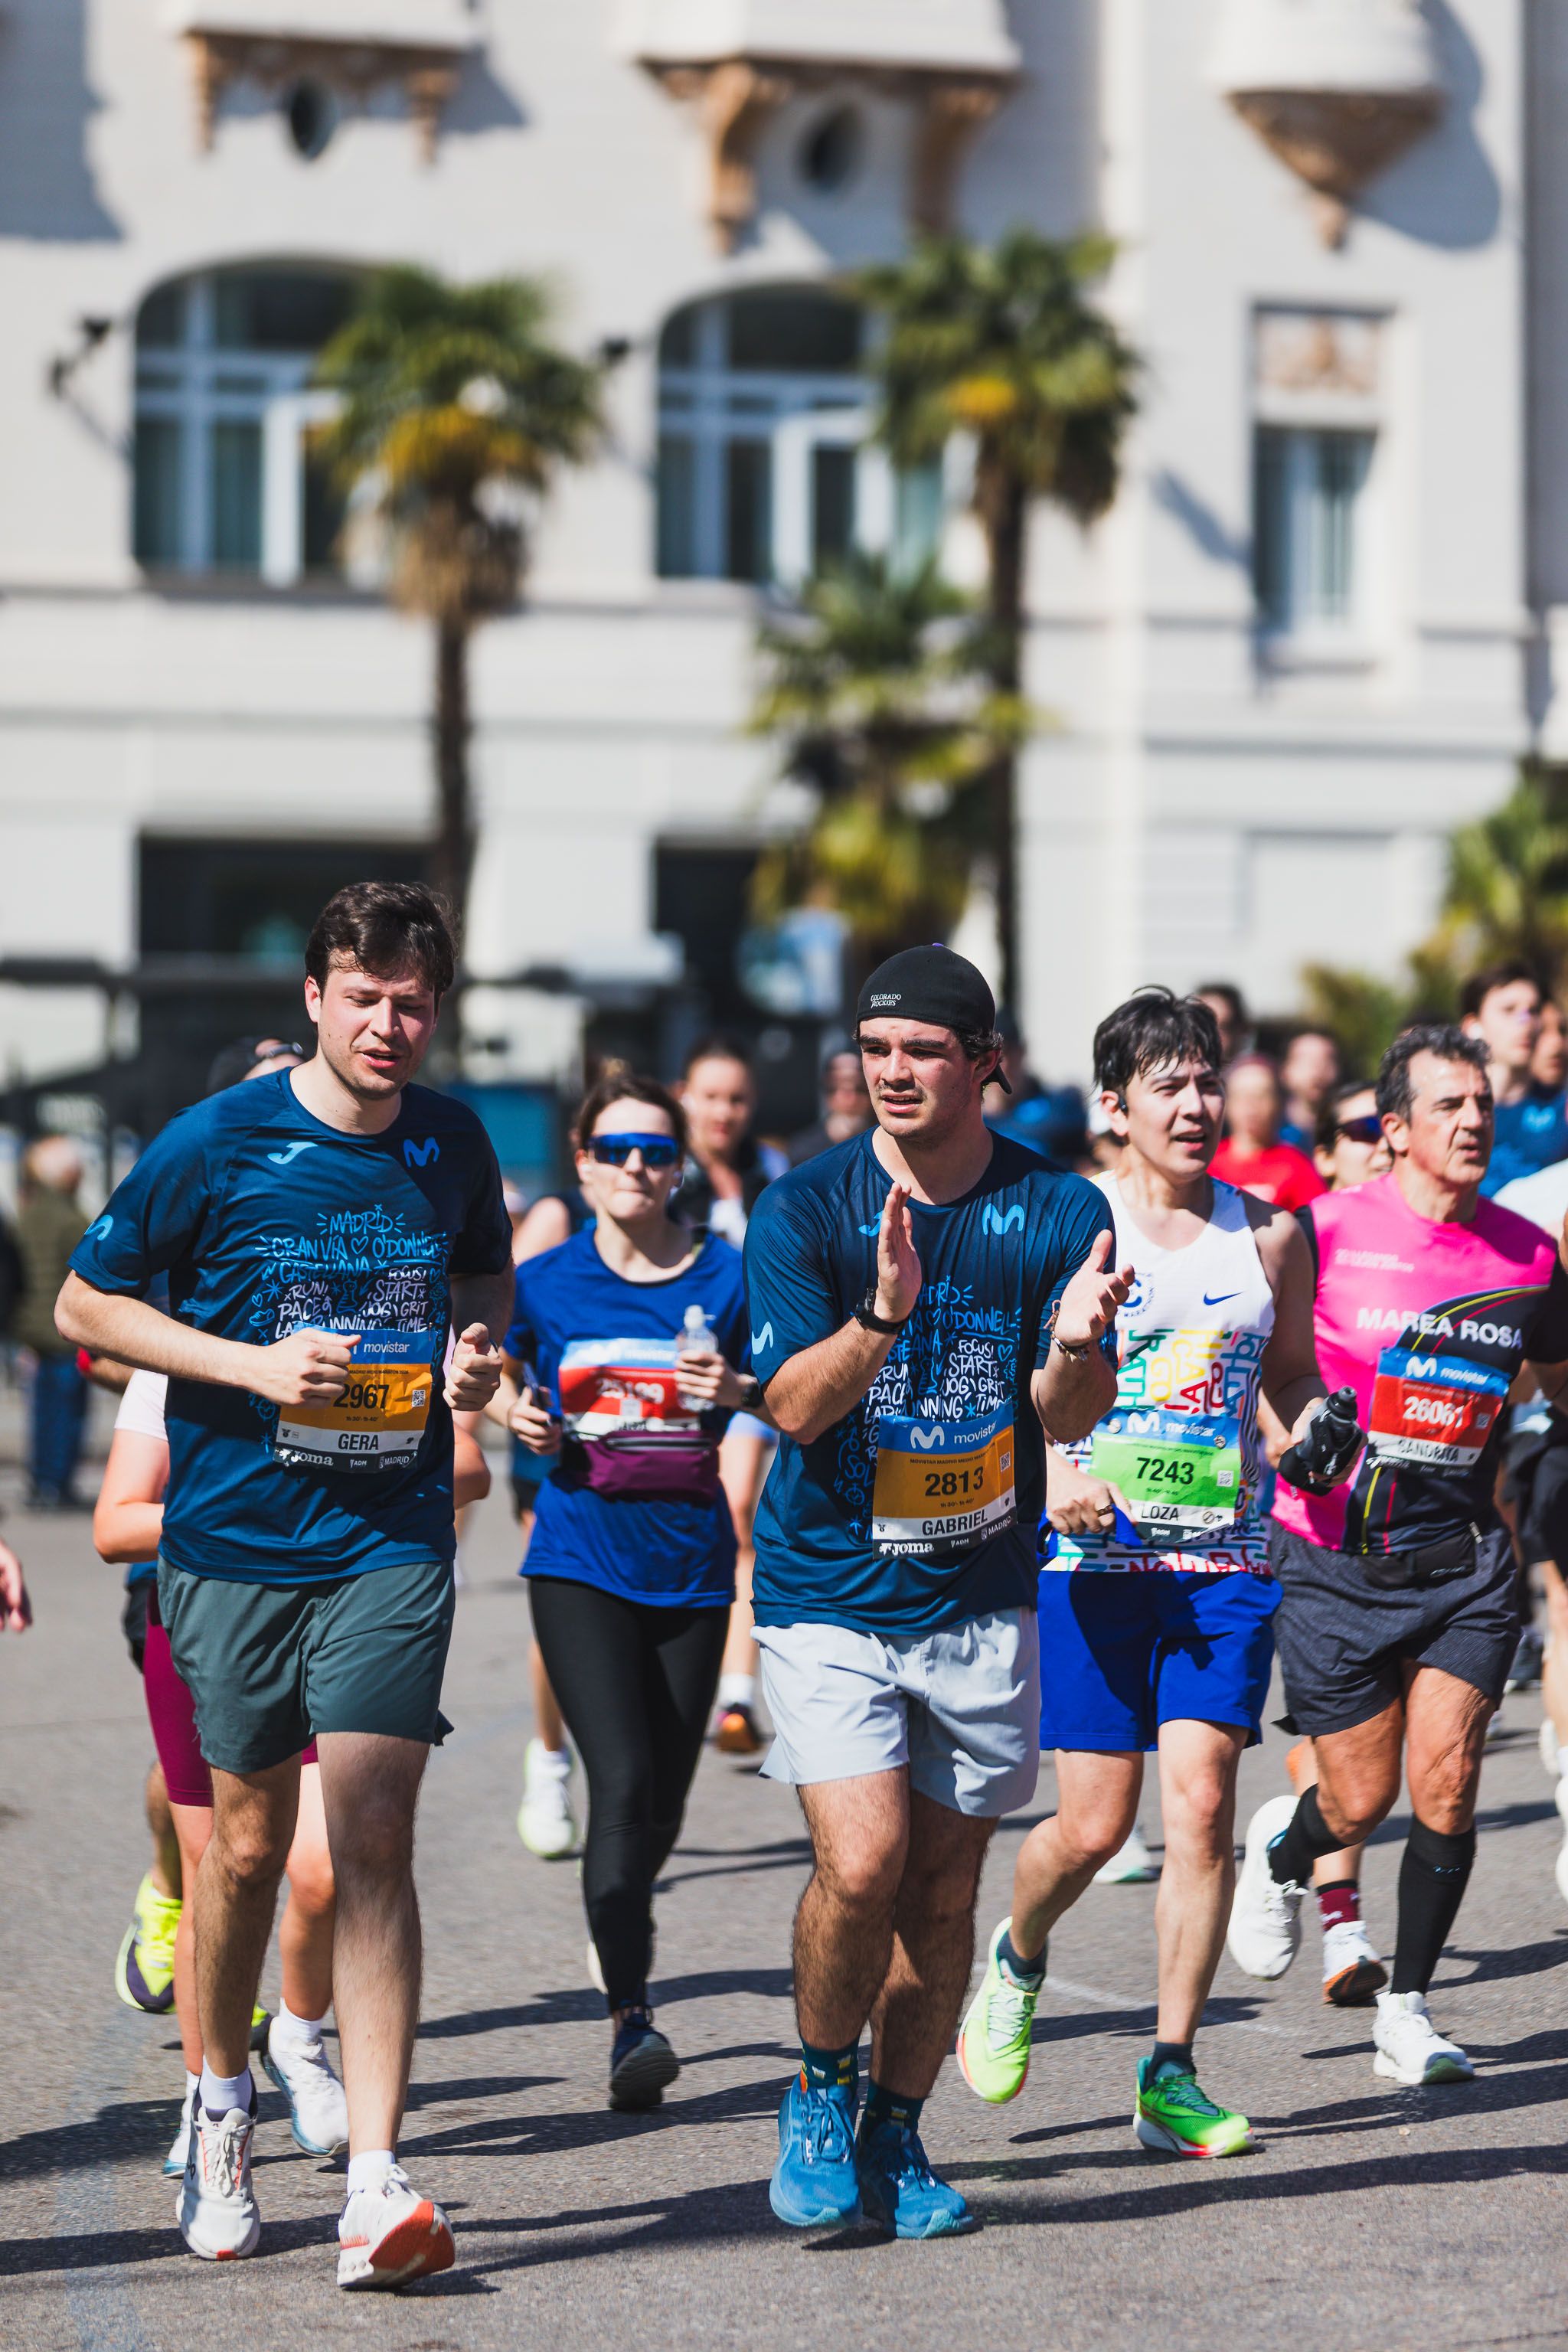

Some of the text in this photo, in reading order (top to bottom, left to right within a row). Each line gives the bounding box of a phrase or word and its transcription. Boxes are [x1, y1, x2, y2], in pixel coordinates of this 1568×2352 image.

[871, 1000, 896, 1008] ROCKIES
[329, 1207, 394, 1235] MADRID
[272, 1236, 318, 1261] GRAN
[279, 1256, 372, 1283] CASTELLANA
[388, 1265, 427, 1281] FOCUS!
[289, 1281, 329, 1301] RUN!
[375, 1279, 426, 1302] START
[919, 1279, 961, 1306] ADRID
[277, 1298, 322, 1321] PACE
[942, 1306, 1014, 1335] O'DONNELL
[1357, 1307, 1523, 1350] MAREA ROSA
[364, 1341, 410, 1354] movistar
[959, 1338, 994, 1359] FOCUS!
[949, 1352, 998, 1377] START
[333, 1383, 390, 1410] 2967
[942, 1377, 969, 1397] JOG
[978, 1377, 1005, 1398] GRIT
[1403, 1396, 1465, 1429] 26061
[338, 1433, 379, 1450] GERA
[954, 1421, 997, 1444] movista
[1165, 1422, 1216, 1438] movistar
[384, 1456, 410, 1465] MADRID
[1136, 1456, 1195, 1485] 7243
[925, 1465, 984, 1497] 2813
[922, 1509, 988, 1537] GABRIEL
[1141, 1505, 1181, 1522] LOZA
